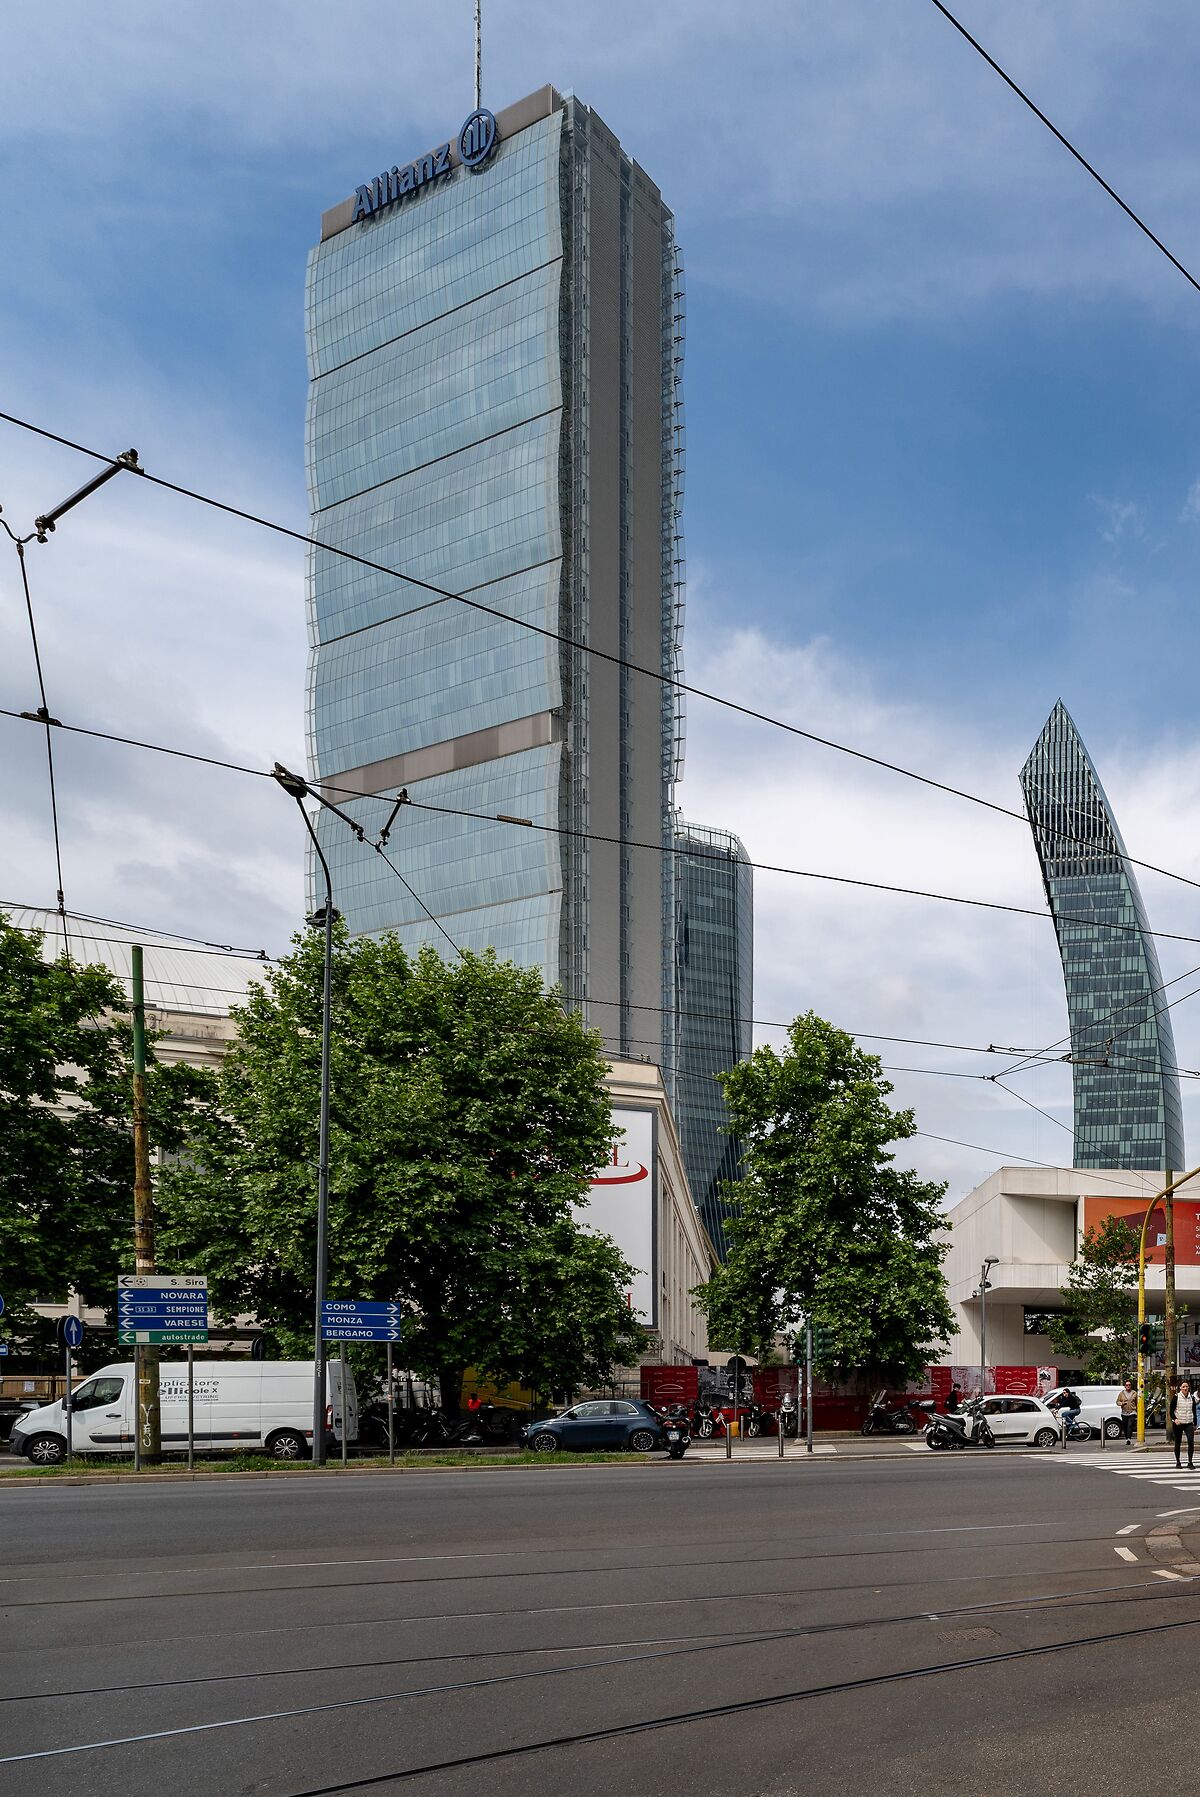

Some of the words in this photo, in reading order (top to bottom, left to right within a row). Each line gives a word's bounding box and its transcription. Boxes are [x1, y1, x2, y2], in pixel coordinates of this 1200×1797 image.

[351, 143, 451, 223] Allianz
[170, 1278, 180, 1286] S.
[185, 1278, 204, 1286] Siro
[325, 1303, 356, 1311] COMO
[164, 1319, 205, 1327] VARESE
[327, 1316, 363, 1324] MONZA
[326, 1329, 373, 1337] BERGAMO
